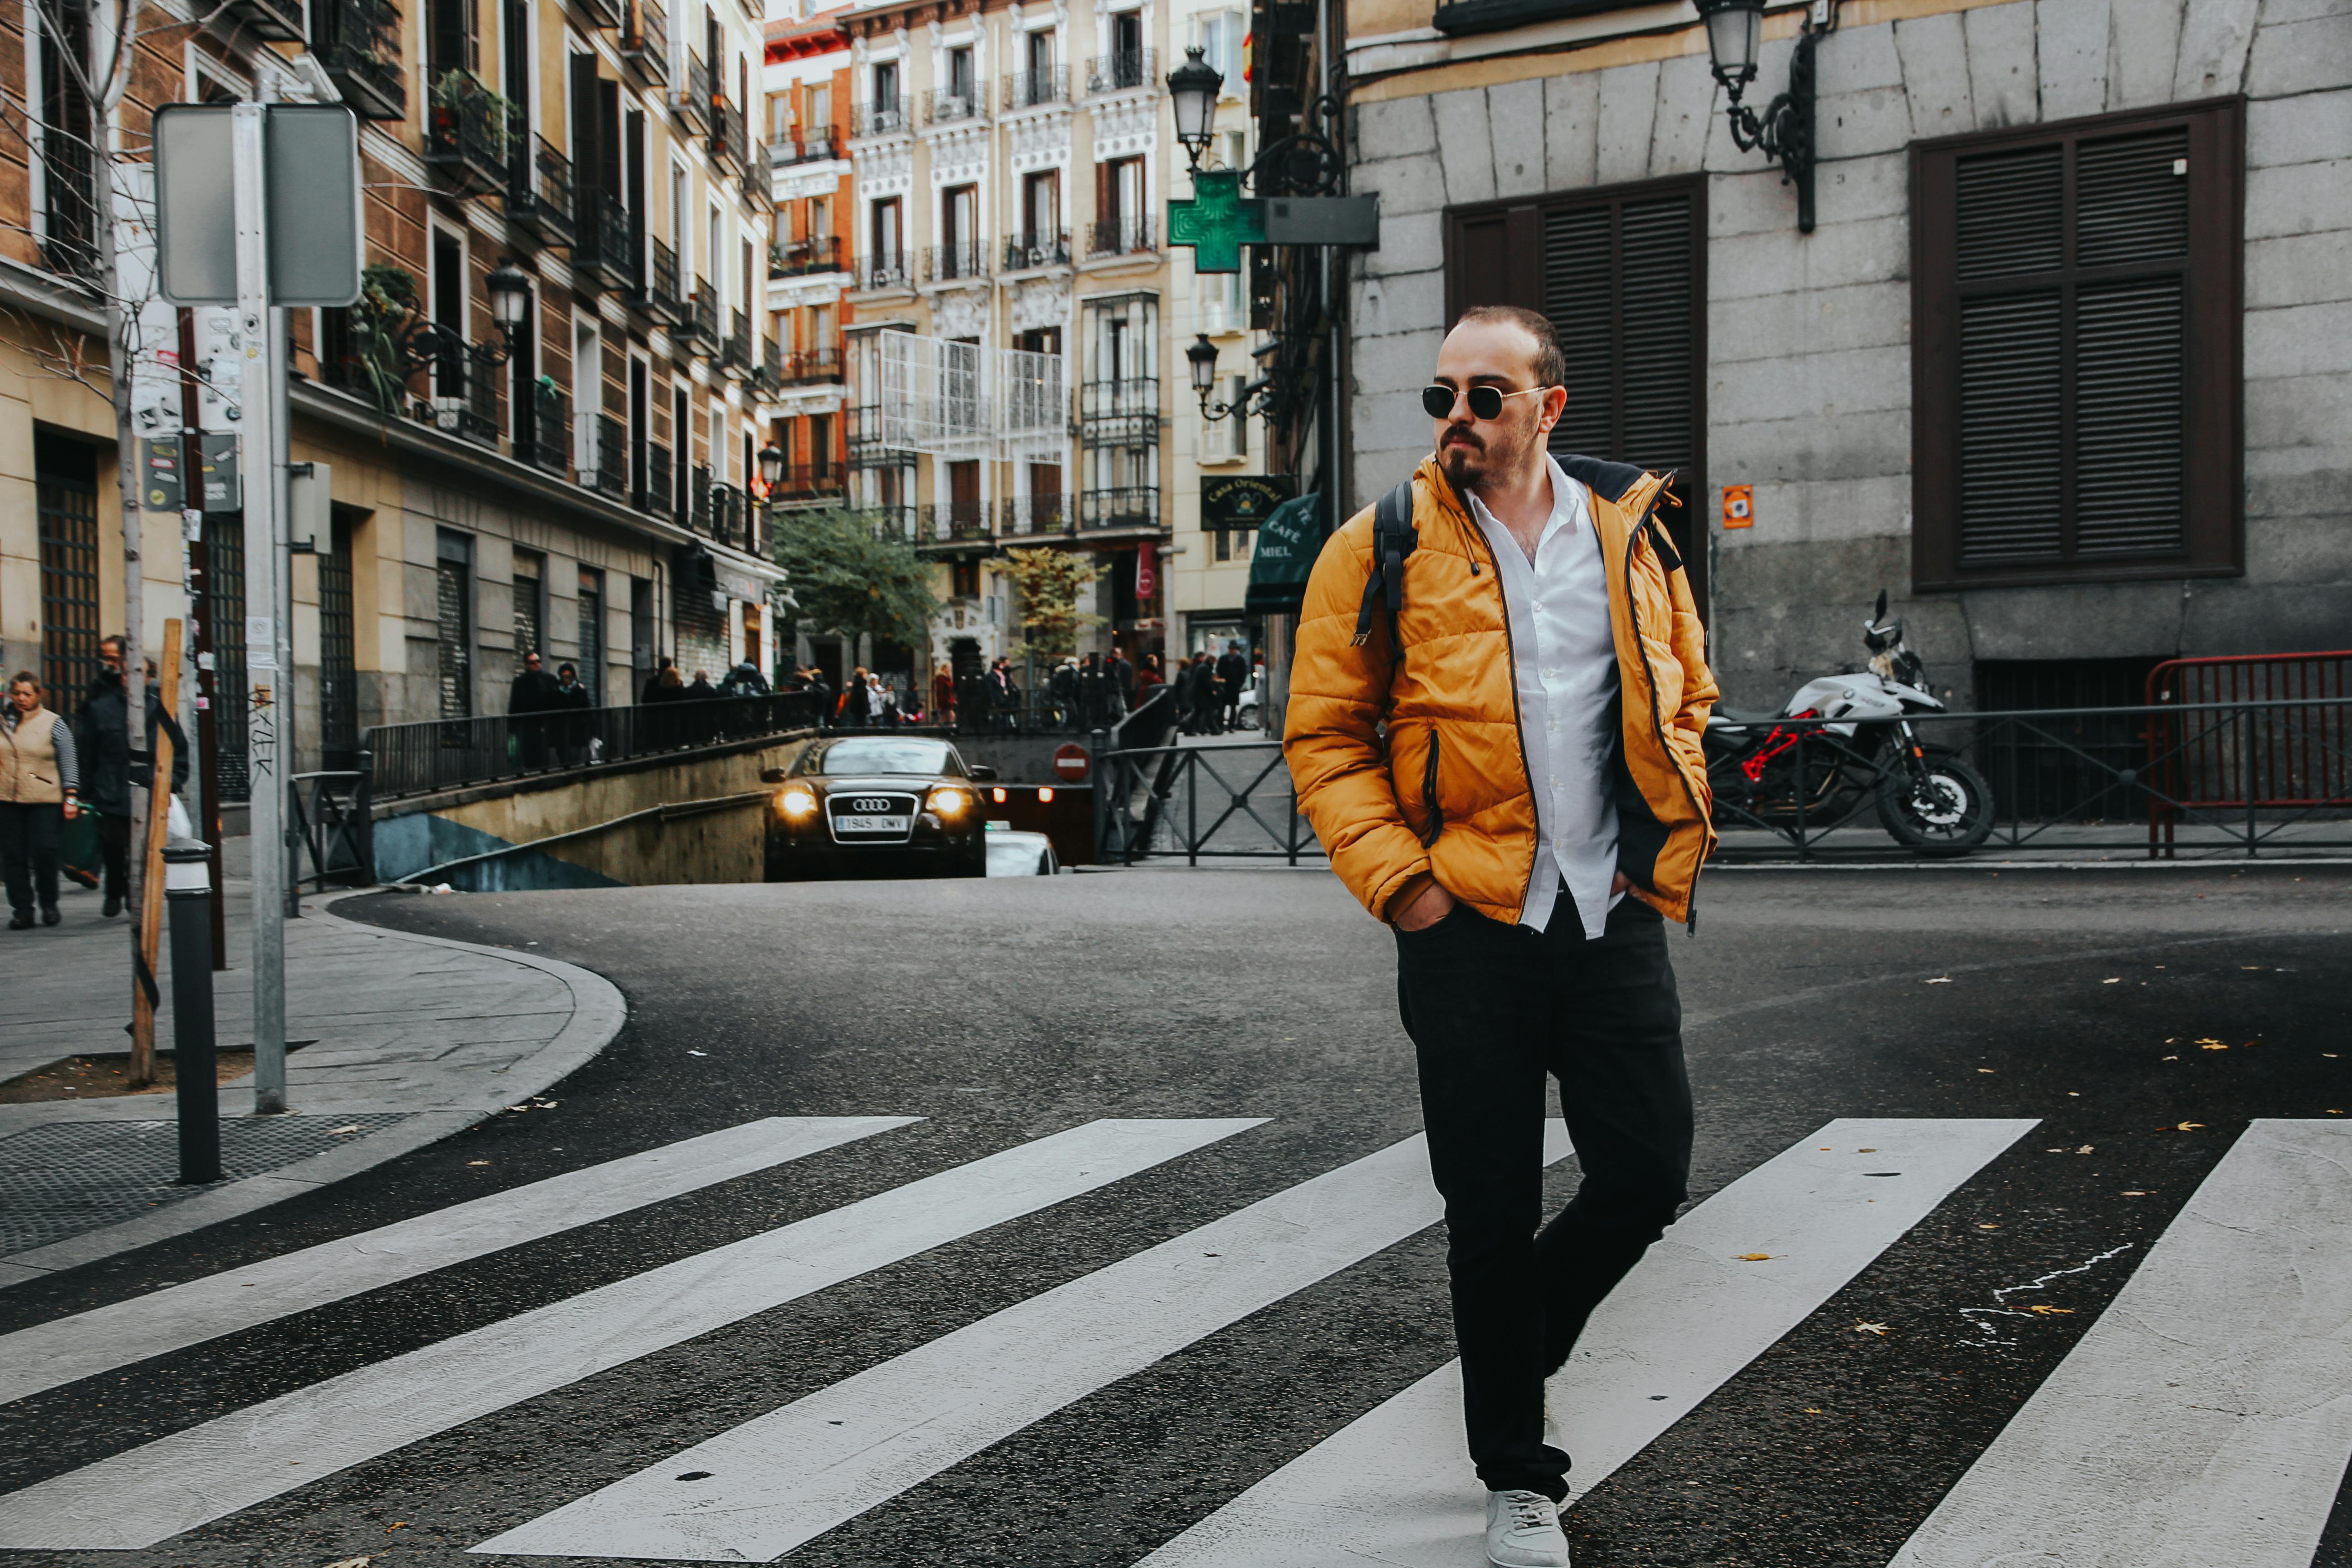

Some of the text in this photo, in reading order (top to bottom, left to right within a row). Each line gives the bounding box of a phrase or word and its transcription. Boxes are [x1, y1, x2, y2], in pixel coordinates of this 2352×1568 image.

[1208, 479, 1282, 502] Casa Oriental
[1268, 520, 1301, 544] CAFÉ
[1260, 546, 1292, 558] MIEL
